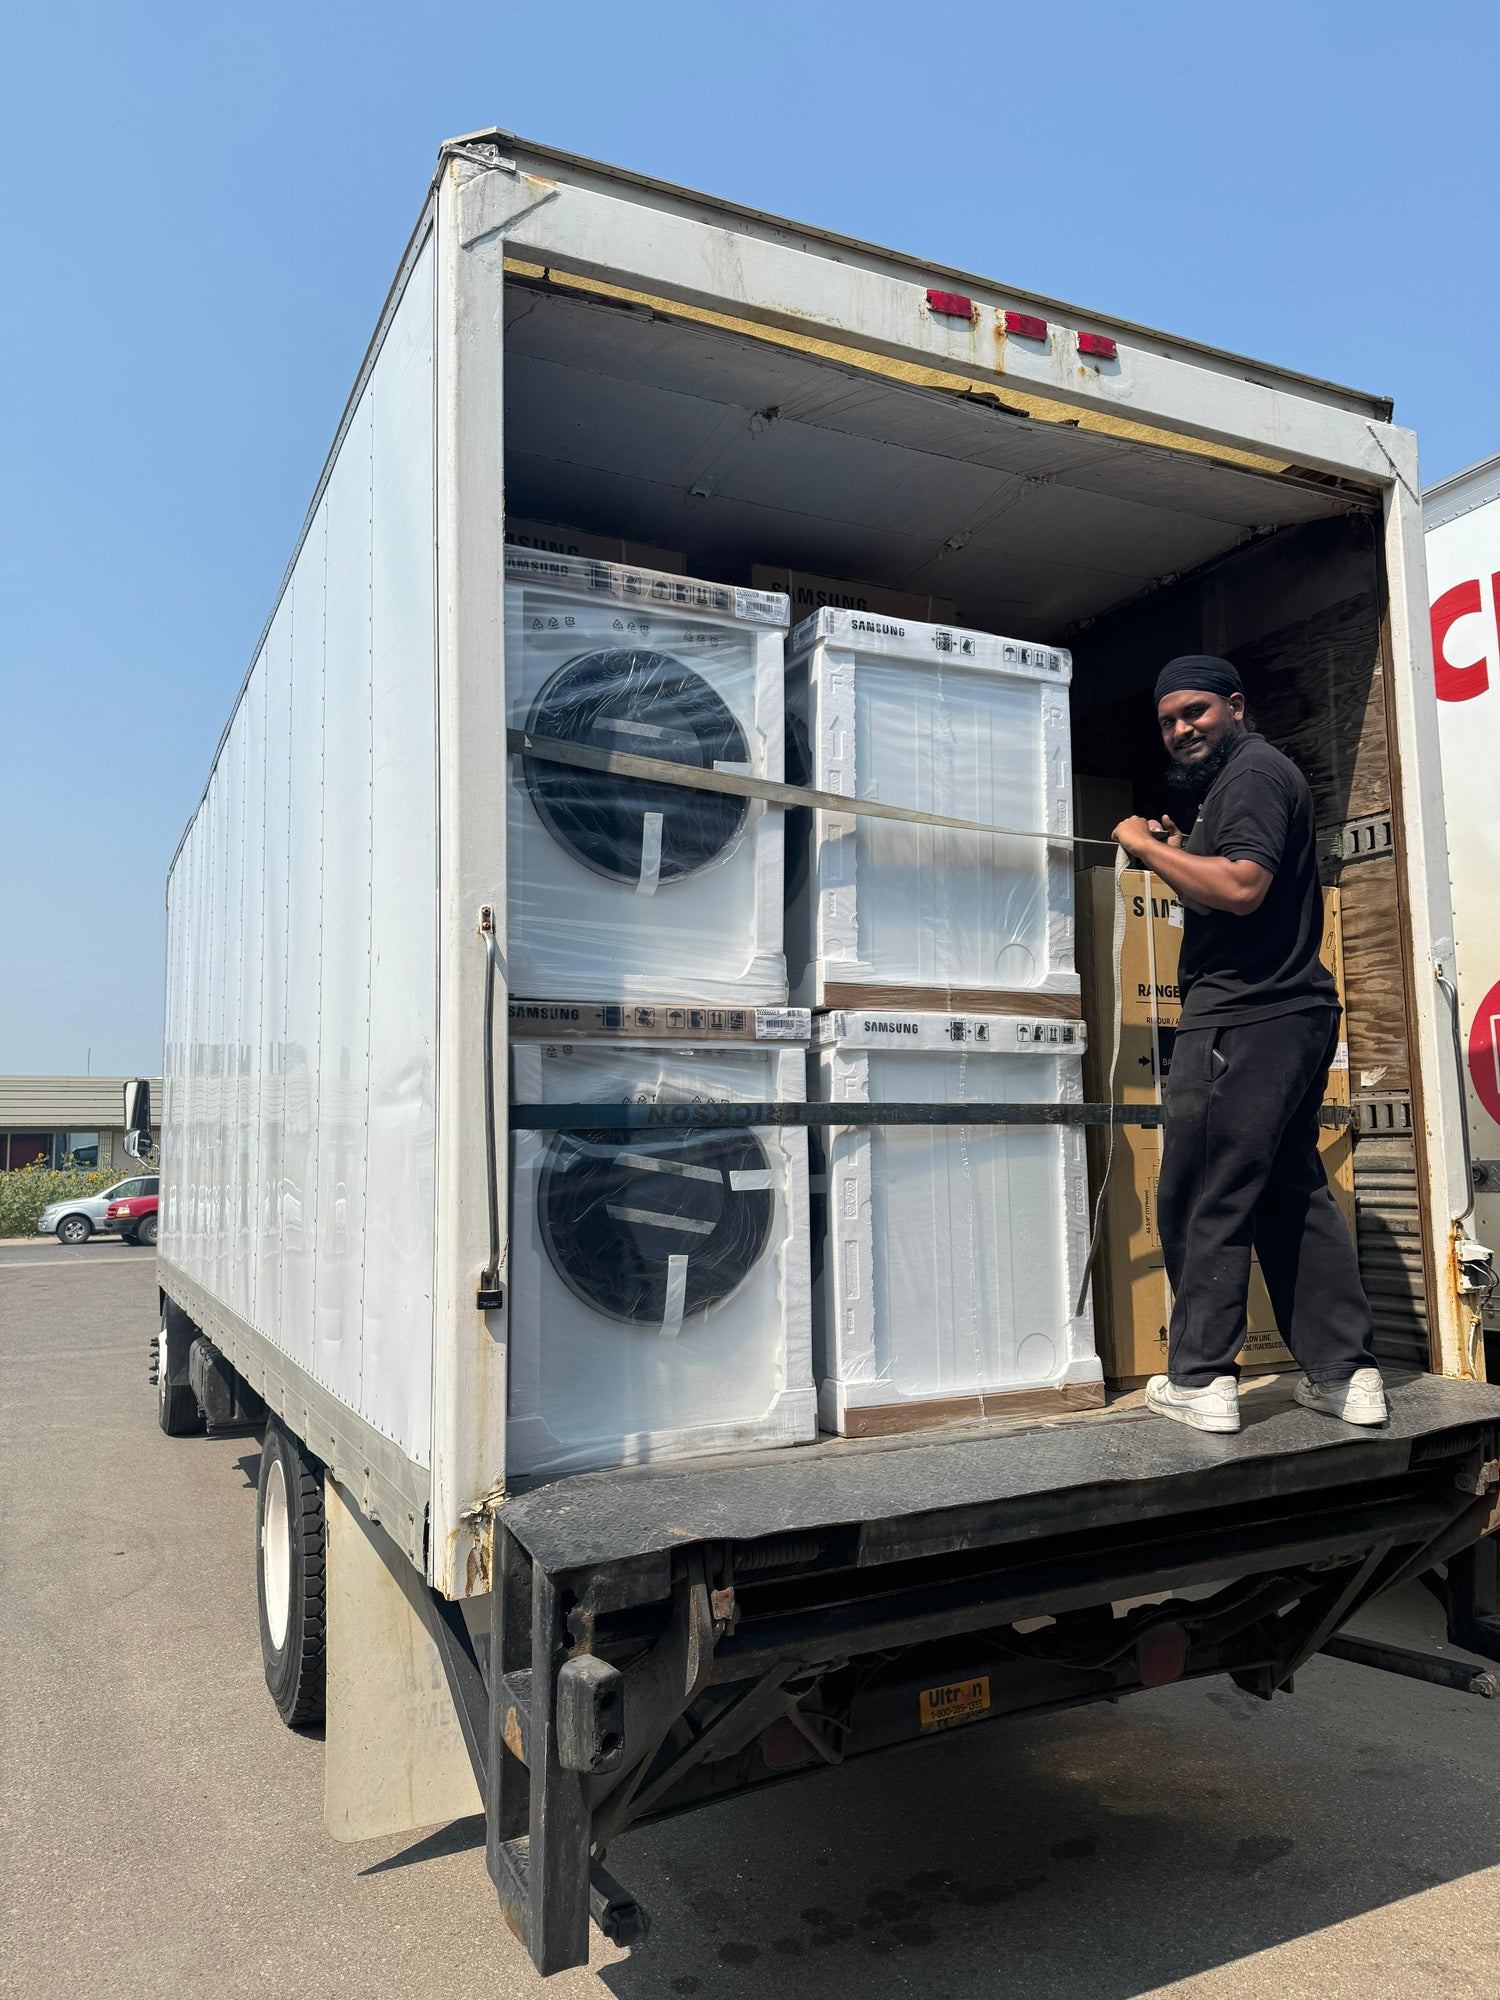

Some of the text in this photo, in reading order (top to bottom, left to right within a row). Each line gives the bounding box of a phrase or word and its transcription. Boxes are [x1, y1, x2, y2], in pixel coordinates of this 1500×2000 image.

[505, 558, 569, 577] AMSUNG
[851, 619, 905, 637] SAMSUNG
[1430, 571, 1500, 702] C
[508, 1005, 579, 1021] SAMSUNG
[864, 1021, 919, 1034] SAMSUNG
[1163, 1058, 1172, 1066] BA
[647, 1104, 801, 1124] ERICKSON
